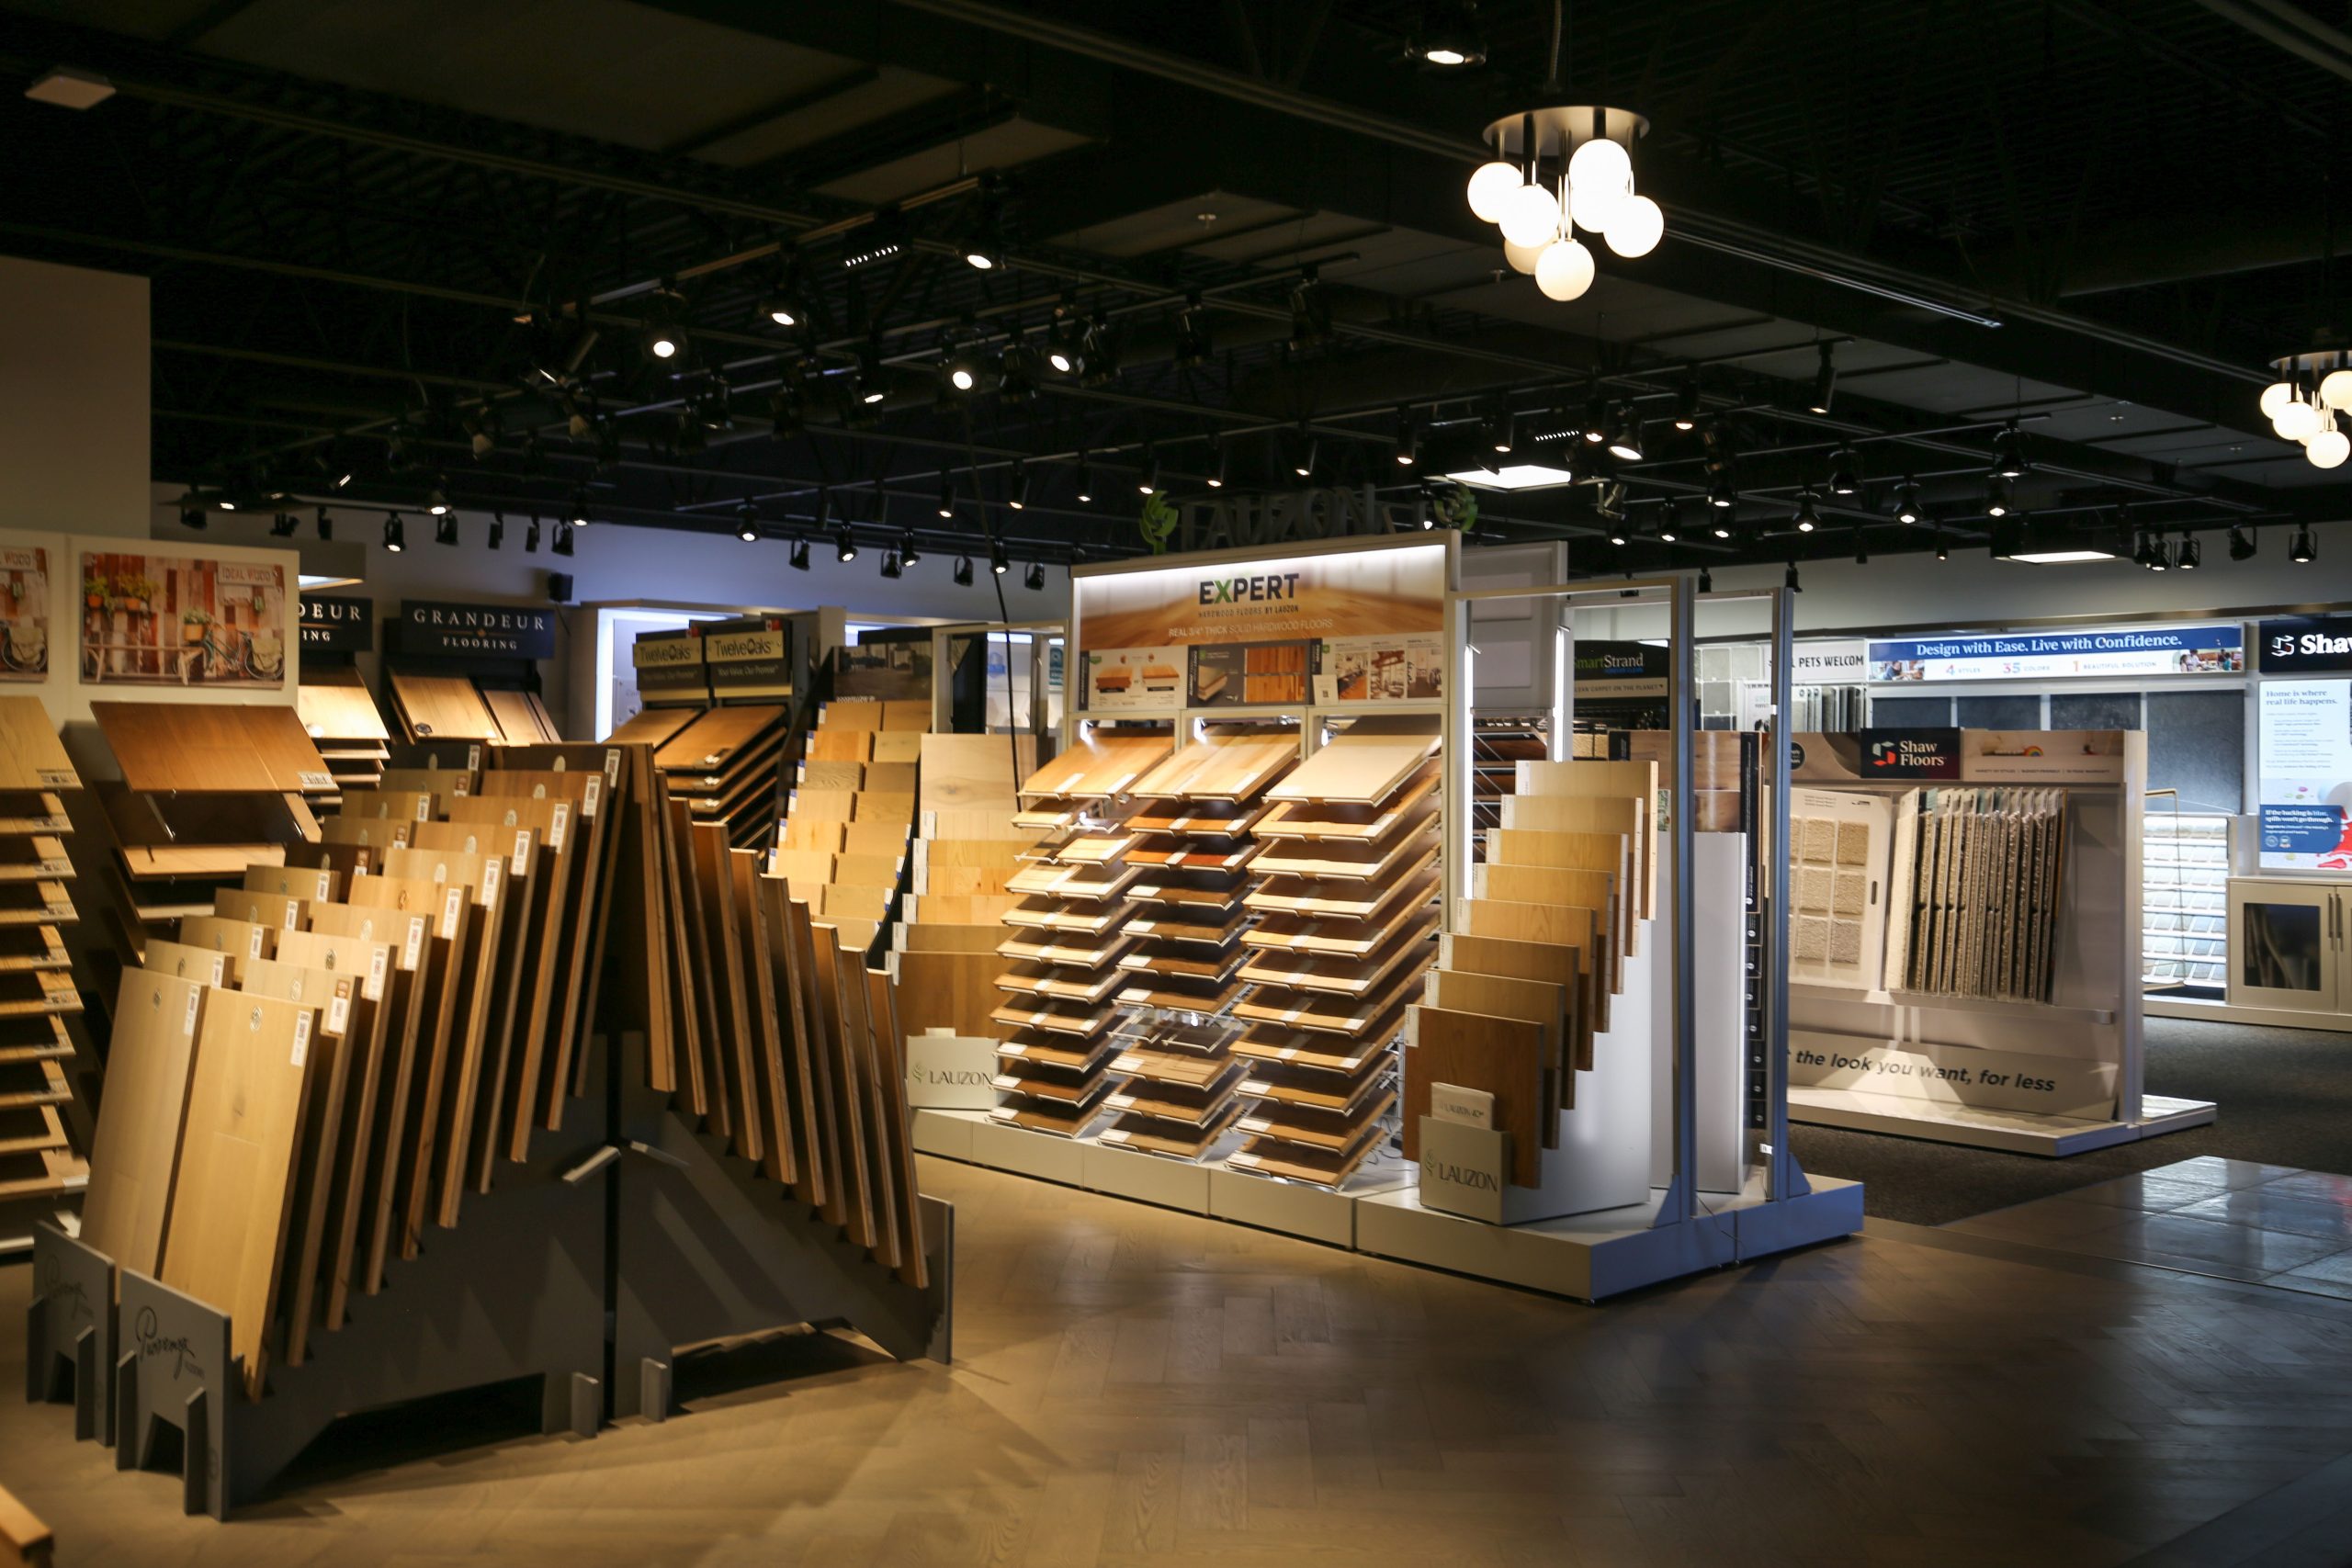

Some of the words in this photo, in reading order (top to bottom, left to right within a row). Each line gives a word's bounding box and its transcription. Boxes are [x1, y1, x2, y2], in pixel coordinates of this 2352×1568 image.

[1199, 573, 1300, 605] EXPERT
[413, 607, 546, 630] GRANDEUR
[1264, 606, 1273, 615] BY
[1169, 626, 1188, 638] REAL
[1204, 625, 1227, 636] THICK
[442, 636, 517, 650] FLOORING
[715, 637, 773, 658] TwelveOaks
[1917, 644, 1961, 658] Design
[1962, 642, 1993, 655] with
[1995, 641, 2029, 653] Ease.
[2031, 639, 2059, 652] Live
[2061, 637, 2092, 650] with
[2094, 634, 2183, 649] Confidence.
[2300, 634, 2352, 655] Sha
[1799, 656, 1822, 668] PETS
[1824, 655, 1864, 667] WELCOM
[1945, 664, 1956, 676] 4
[2002, 661, 2021, 674] 35
[2073, 660, 2079, 672] 1
[2299, 698, 2338, 706] happens.
[1899, 739, 1938, 753] Shaw
[1900, 753, 1944, 767] Floors
[929, 1069, 993, 1086] LAUZON
[1795, 1050, 1826, 1066] the
[1830, 1053, 1872, 1071] look
[1877, 1061, 1912, 1076] you
[1919, 1066, 1973, 1086] want,
[1978, 1068, 2010, 1087] for
[2014, 1073, 2056, 1092] less
[1439, 1162, 1498, 1192] LAUZON
